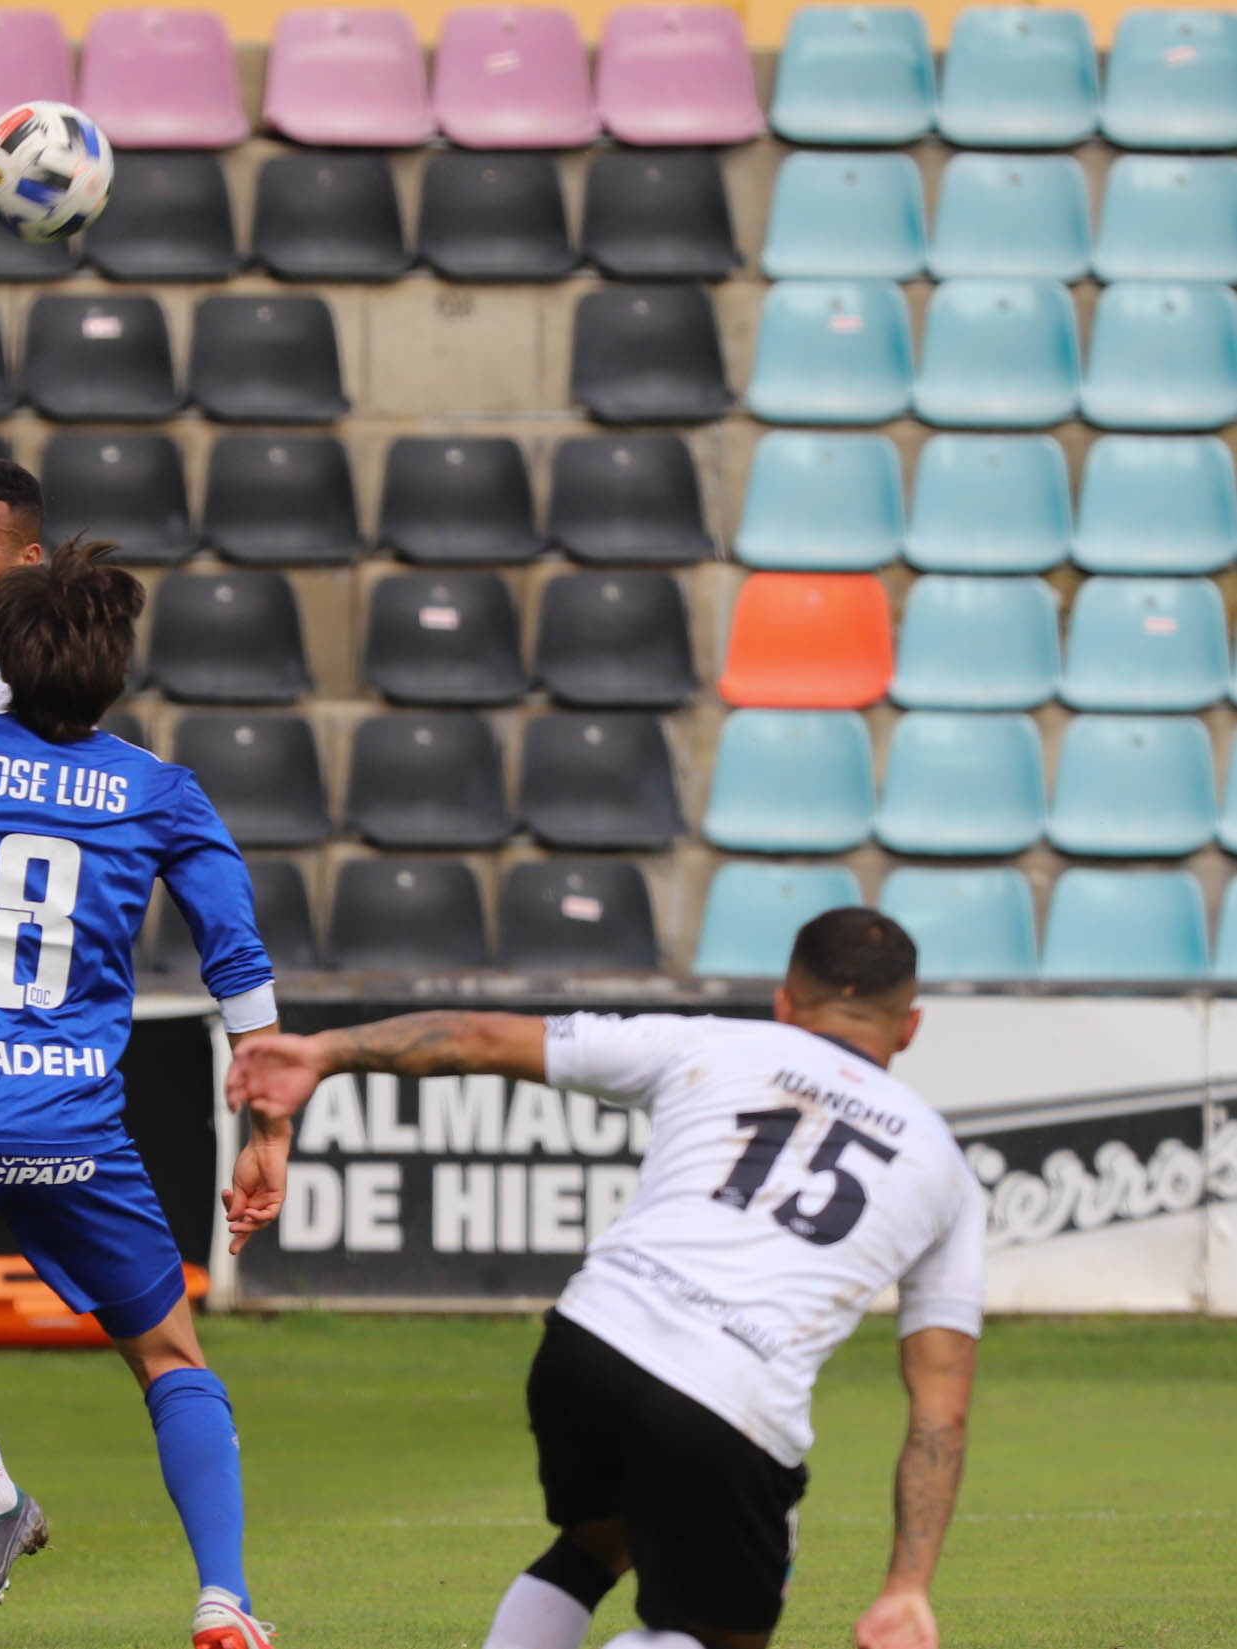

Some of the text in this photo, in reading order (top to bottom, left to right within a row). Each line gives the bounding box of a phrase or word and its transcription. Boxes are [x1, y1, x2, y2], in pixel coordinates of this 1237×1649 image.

[56, 765, 129, 815] LUIS
[769, 1068, 908, 1137] JUANCHO
[278, 1160, 404, 1253] DE
[710, 1106, 900, 1246] 15
